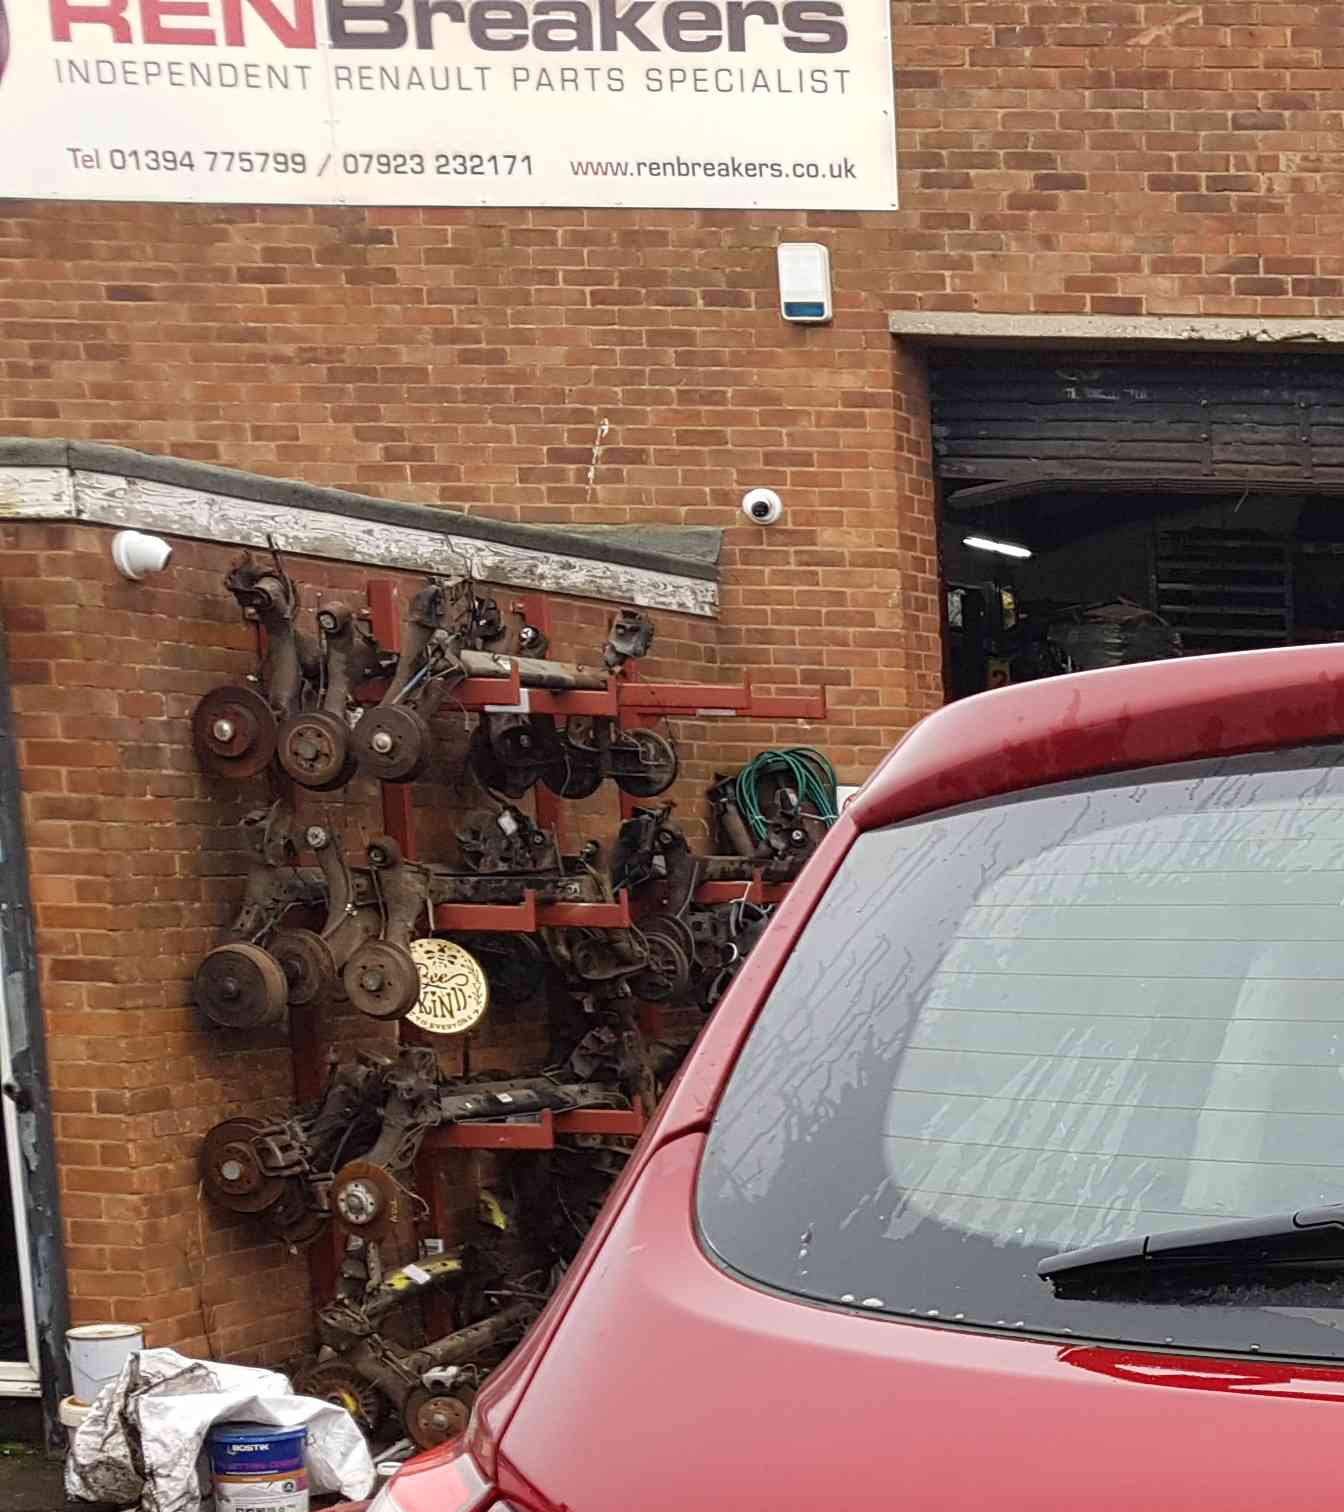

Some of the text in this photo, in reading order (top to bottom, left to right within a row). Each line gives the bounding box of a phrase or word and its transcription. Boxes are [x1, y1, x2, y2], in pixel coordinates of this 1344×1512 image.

[56, 60, 851, 94] INDEPENDENT RENAULT PARTS SPECIALIST
[67, 148, 101, 169] Tel
[110, 149, 195, 172] 01394
[204, 151, 307, 174] 775799
[343, 153, 425, 175] 07923
[435, 154, 533, 176] 232171
[570, 156, 857, 179] www.renbreakers.co.uk
